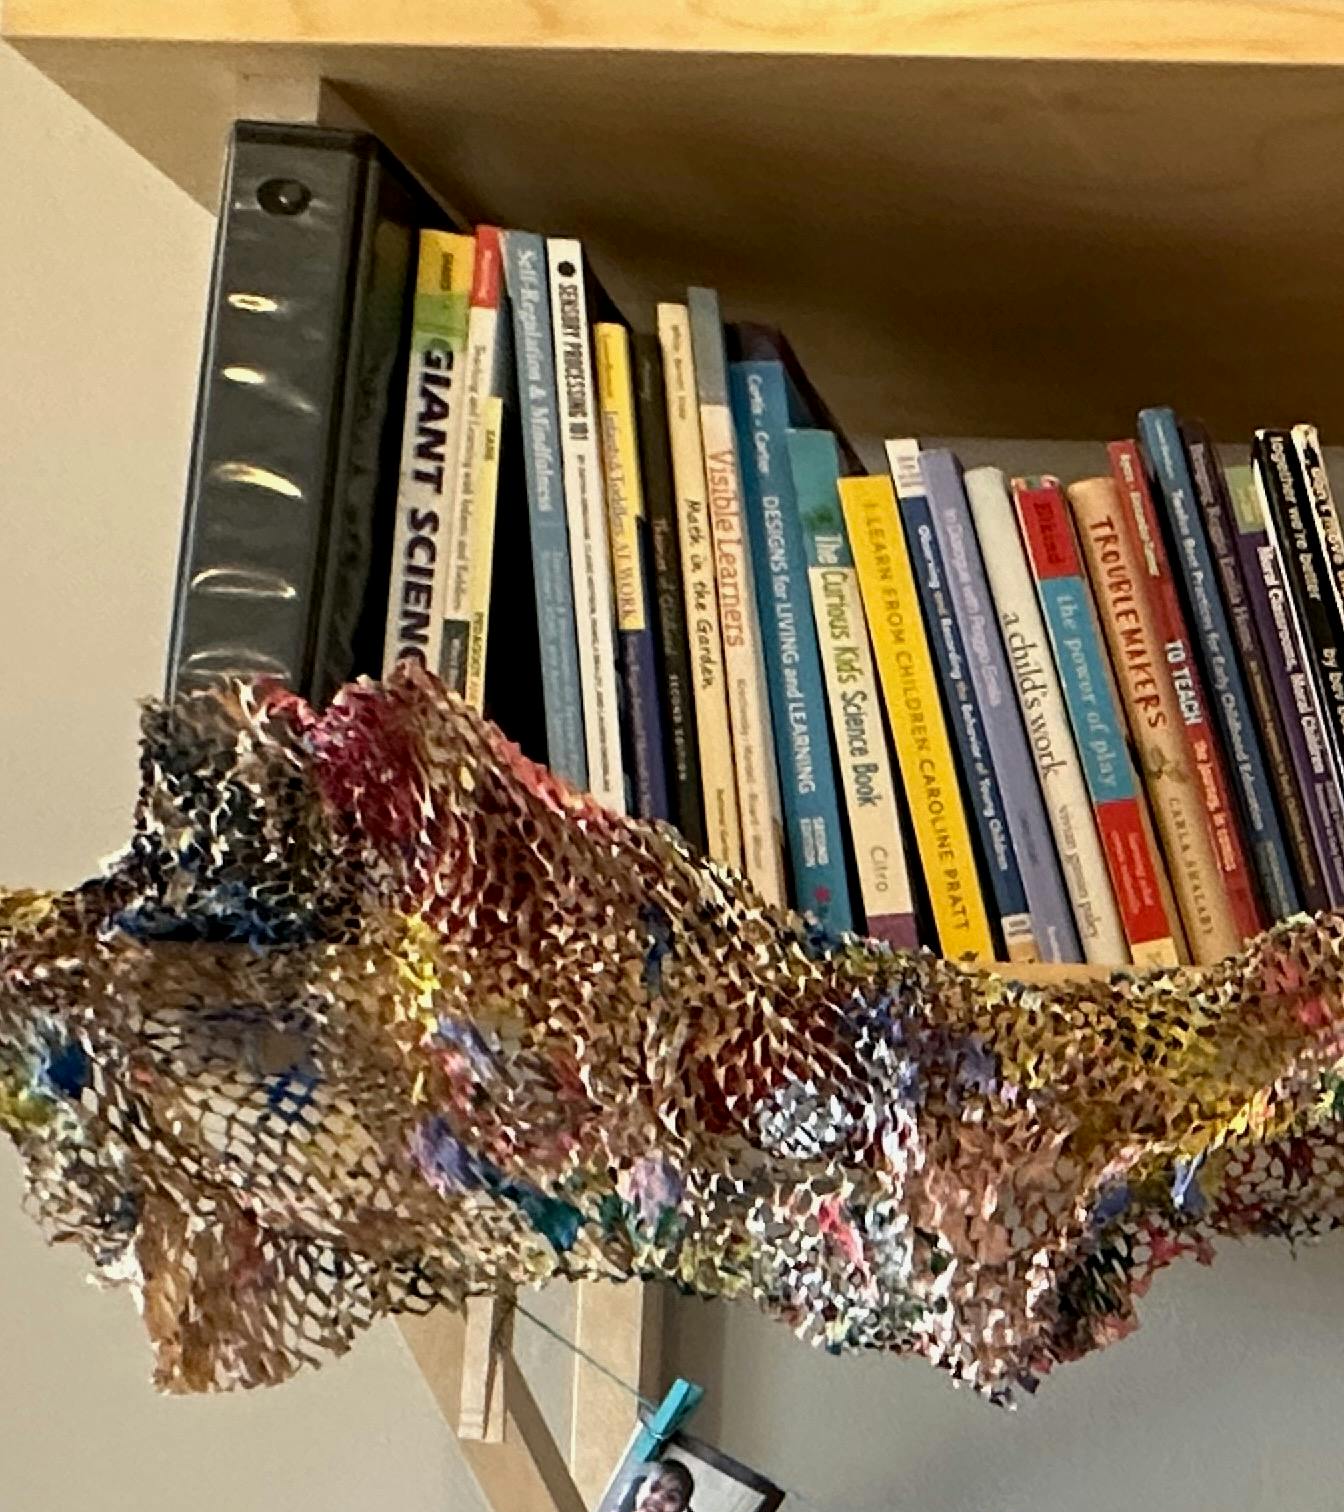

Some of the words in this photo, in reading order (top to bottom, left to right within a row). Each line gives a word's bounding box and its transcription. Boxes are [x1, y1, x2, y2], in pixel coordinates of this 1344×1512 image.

[517, 249, 544, 382] Self-Regulation
[559, 283, 581, 338] SENSORY
[528, 384, 547, 401] &
[563, 341, 589, 418] PROCESSING
[749, 374, 765, 415] Curtis
[412, 338, 454, 495] GIANT
[569, 421, 590, 441] 101
[531, 404, 558, 511] Mindfulness
[754, 431, 771, 474] Carter
[708, 450, 742, 532] Visible
[615, 543, 633, 560] AT
[686, 500, 708, 547] Math
[762, 496, 789, 573] DESIGNS
[814, 533, 844, 565] The
[1033, 502, 1067, 565] Elkind
[1269, 437, 1298, 504] together
[1288, 505, 1310, 551] we're
[1299, 552, 1322, 602] better
[1320, 647, 1340, 669] by
[398, 507, 440, 672] SCIENC
[619, 565, 639, 621] WORK
[689, 554, 707, 574] in
[716, 538, 748, 648] Learners
[771, 575, 791, 598] for
[1256, 545, 1281, 587] Moral
[693, 580, 713, 611] the
[820, 567, 855, 640] Curious
[1002, 610, 1022, 628] a
[1056, 594, 1079, 631] the
[697, 619, 718, 690] Garden
[775, 601, 802, 664] LIVING
[1164, 639, 1186, 665] TO
[1268, 587, 1298, 673] Classrooms,
[784, 667, 804, 699] and
[833, 646, 865, 685] Kid's
[1009, 632, 1049, 710] child's
[1063, 638, 1098, 704] power
[1182, 536, 1200, 569] Best
[1191, 569, 1214, 631] Practices
[1210, 655, 1230, 691] Early
[1220, 692, 1250, 762] Childhood
[1238, 762, 1265, 832] Education
[1289, 672, 1313, 715] Moral
[840, 690, 869, 757] Science
[866, 517, 892, 581] LEARN
[884, 587, 907, 646] FROM
[896, 650, 933, 752] CHILDREN
[918, 758, 956, 864] CAROLINE
[943, 867, 971, 931] PRATT
[1087, 711, 1111, 735] of
[1090, 515, 1169, 729] TROUBLEMAKERS
[1169, 797, 1191, 853] CARLA
[1184, 860, 1215, 935] SHALABY
[1170, 666, 1203, 726] TEACH
[787, 702, 816, 794] LEARNING
[1029, 712, 1068, 780] work
[1090, 740, 1119, 787] play
[1301, 715, 1325, 775] Children
[852, 763, 882, 808] Book
[869, 845, 891, 893] Citro
